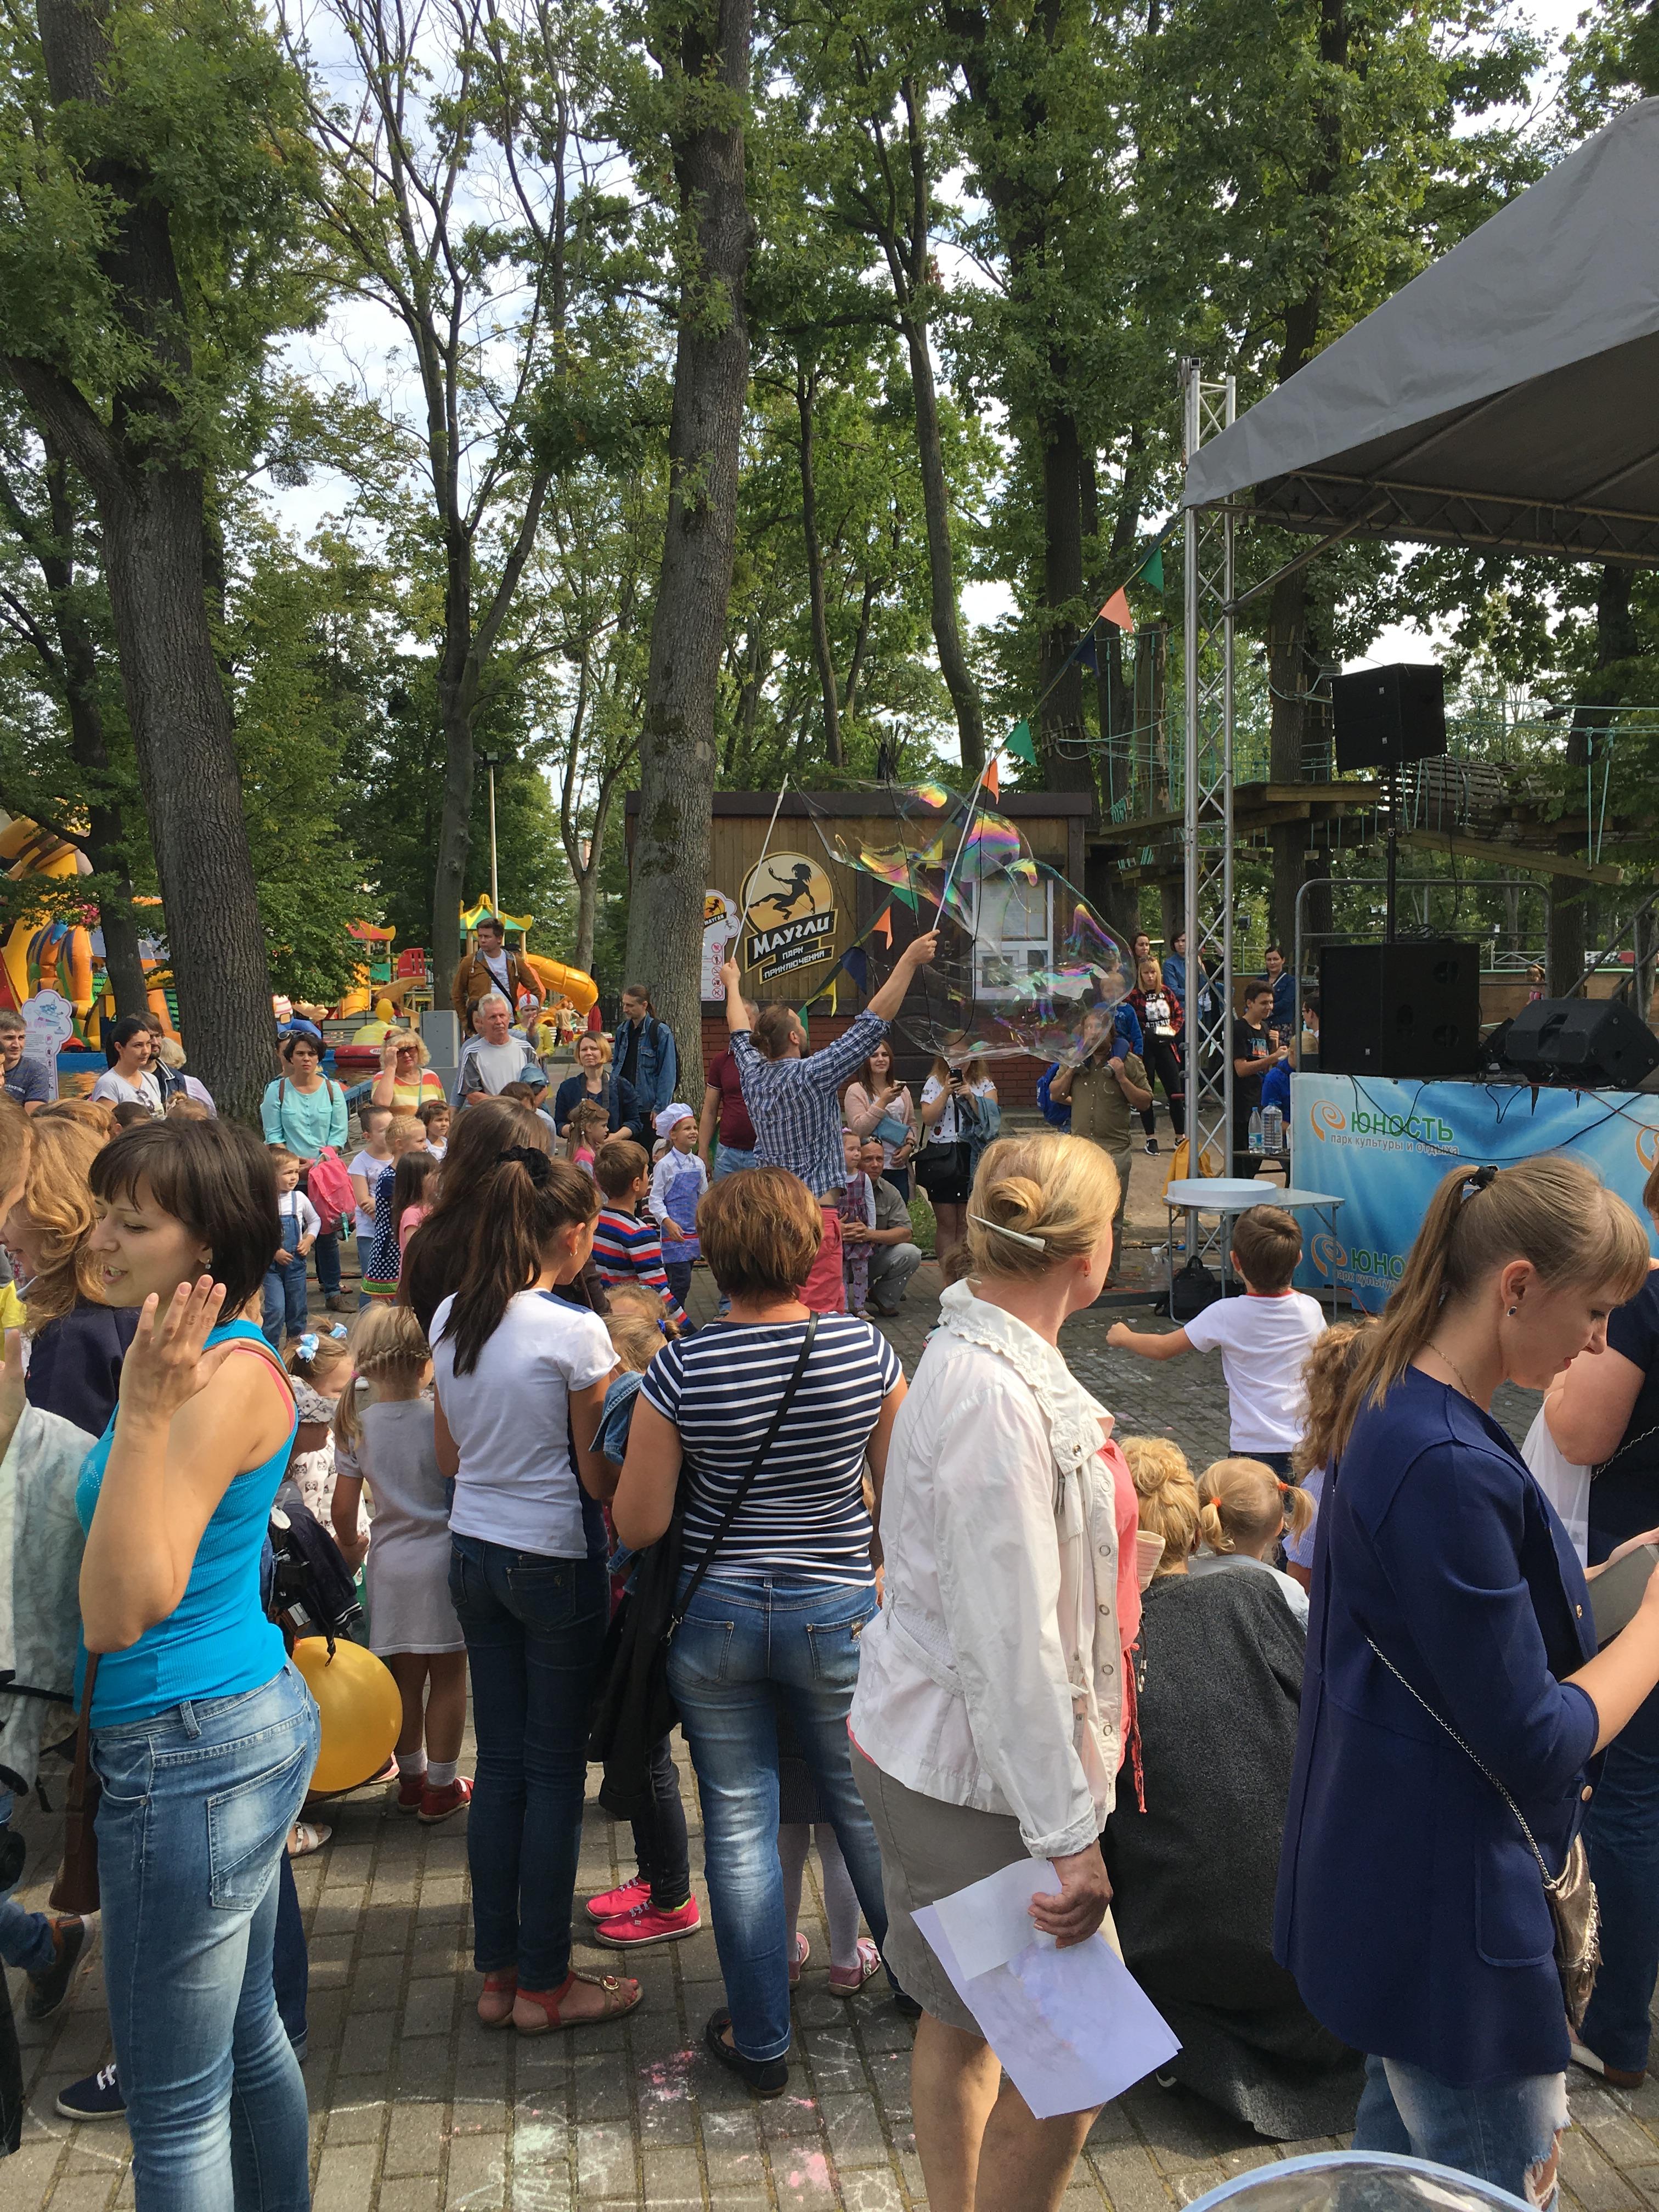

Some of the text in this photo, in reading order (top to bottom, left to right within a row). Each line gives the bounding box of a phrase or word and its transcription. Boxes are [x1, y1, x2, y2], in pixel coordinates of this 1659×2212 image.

[782, 946, 804, 960] ПАРК
[1351, 1111, 1454, 1142] ЮНОСТЬ
[1331, 1134, 1352, 1145] парк
[1355, 1137, 1403, 1151] культуры
[1351, 1248, 1406, 1279] ЮНО
[1357, 1274, 1398, 1291] культу
